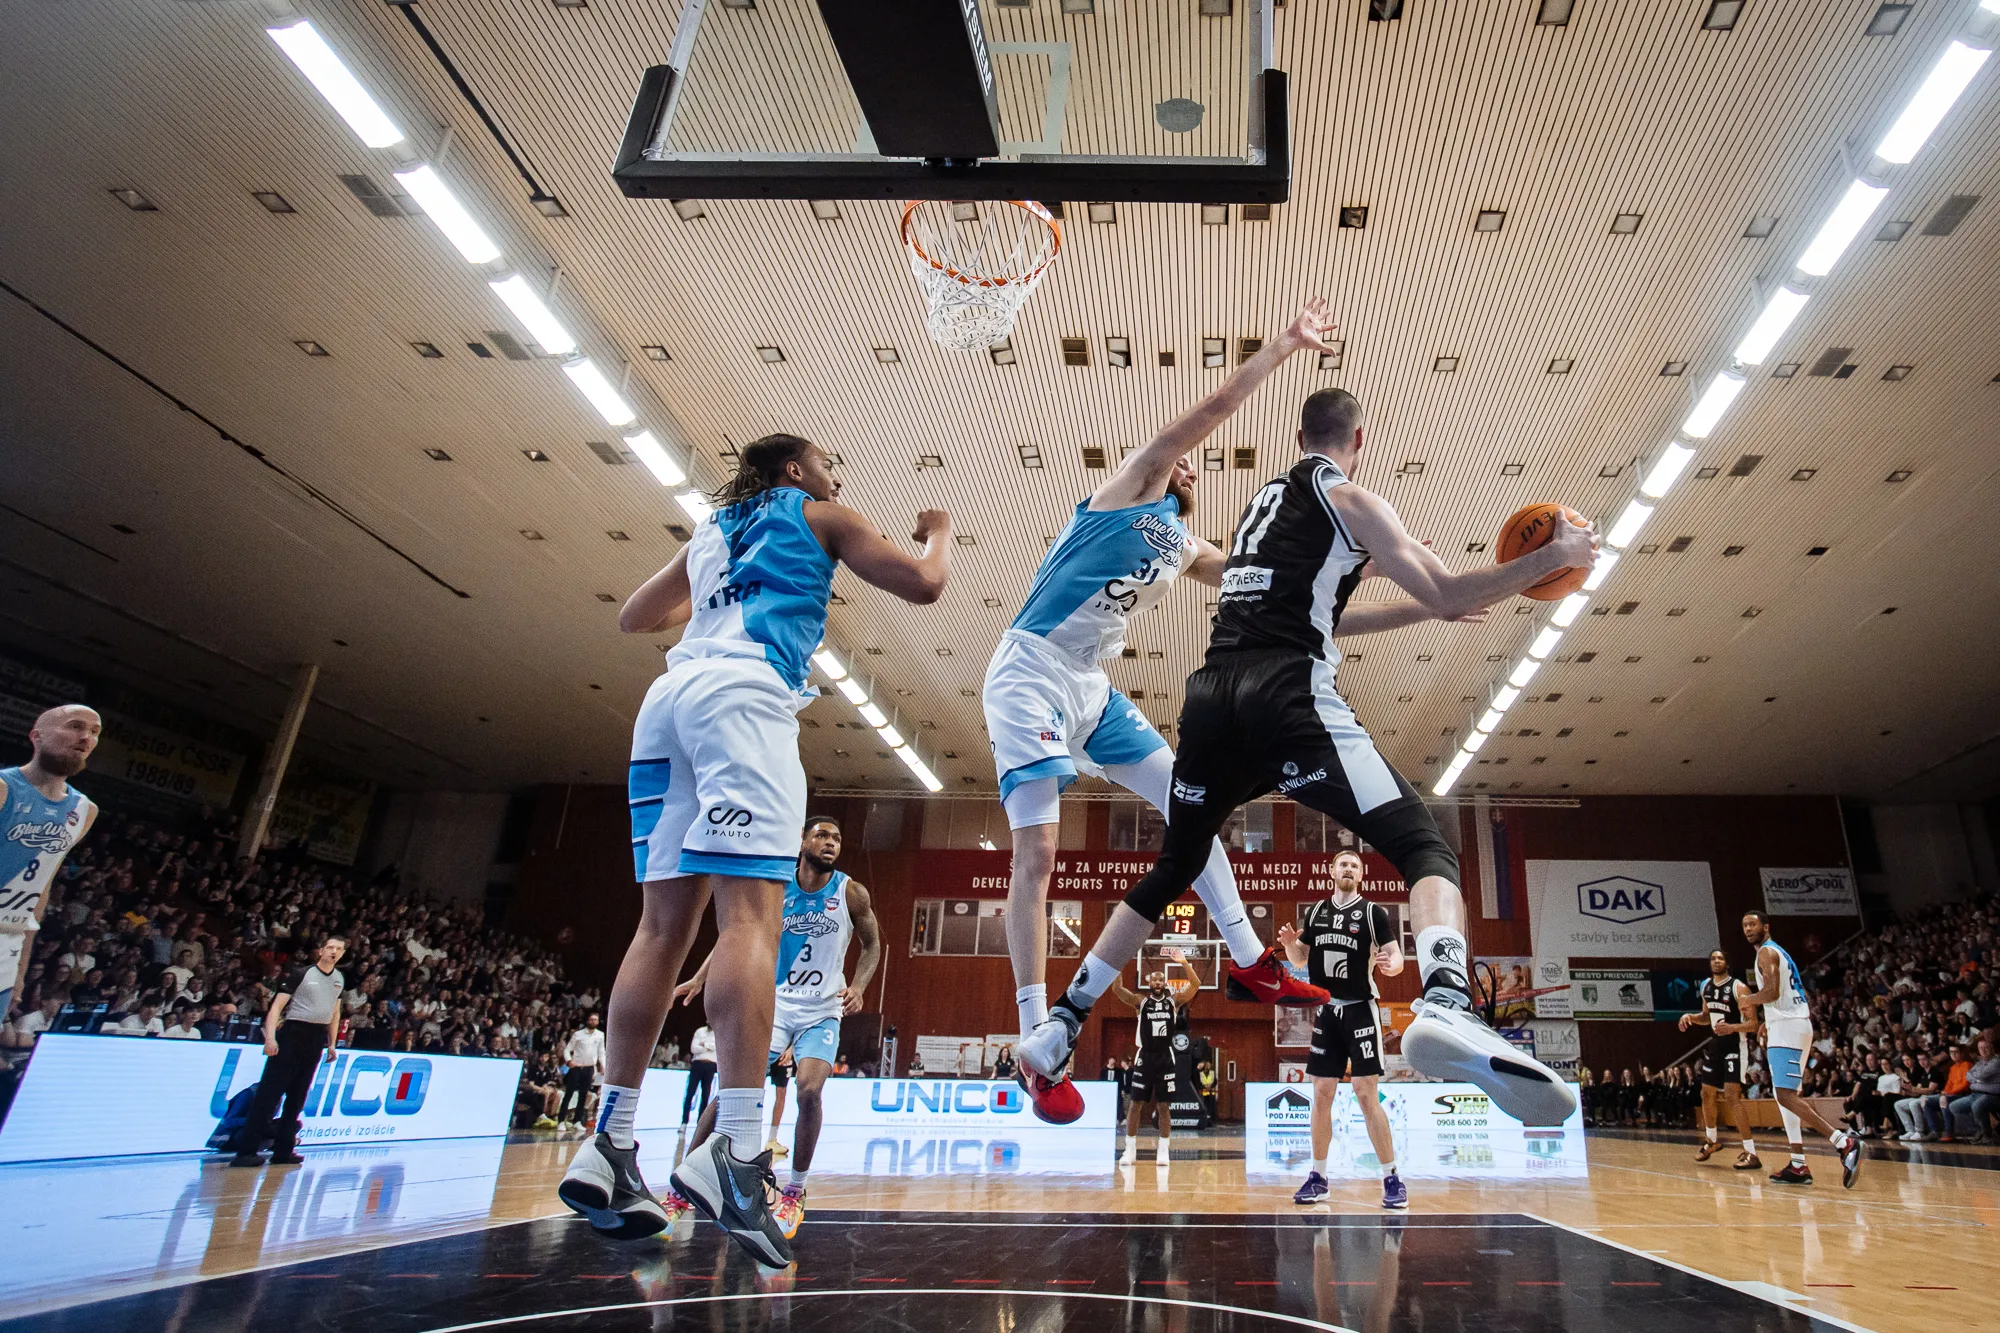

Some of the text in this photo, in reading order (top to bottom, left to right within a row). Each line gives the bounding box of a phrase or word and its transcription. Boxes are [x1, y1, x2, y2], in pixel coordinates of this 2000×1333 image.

[1131, 512, 1167, 535] Blue
[1232, 483, 1287, 556] 17
[1131, 557, 1160, 586] 31
[125, 759, 197, 796] 1988/89
[7, 821, 42, 841] Blue
[22, 858, 41, 882] 8
[1075, 862, 1090, 873] ZA
[1262, 863, 1302, 875] MEDZI
[1056, 878, 1103, 891] SPORTS
[1112, 878, 1128, 890] TO
[1361, 880, 1410, 892] NATION
[1589, 888, 1656, 911] DAK
[782, 911, 839, 933] Blue Wings
[1173, 919, 1191, 934] 13
[1332, 913, 1345, 930] 12
[1315, 932, 1358, 950] PRIEVIDZA
[1570, 931, 1680, 944] stavby bez starosti
[799, 943, 813, 963] 3
[1603, 972, 1644, 980] PRIEVIDZA
[1713, 988, 1720, 1000] 3
[821, 1028, 835, 1046] 3
[1359, 1040, 1375, 1059] 12
[871, 1081, 1025, 1114] UNICO
[1269, 1112, 1310, 1120] POD FAROU
[1436, 1119, 1488, 1127] 0908 600 209
[299, 1124, 396, 1139] chladové izolácie
